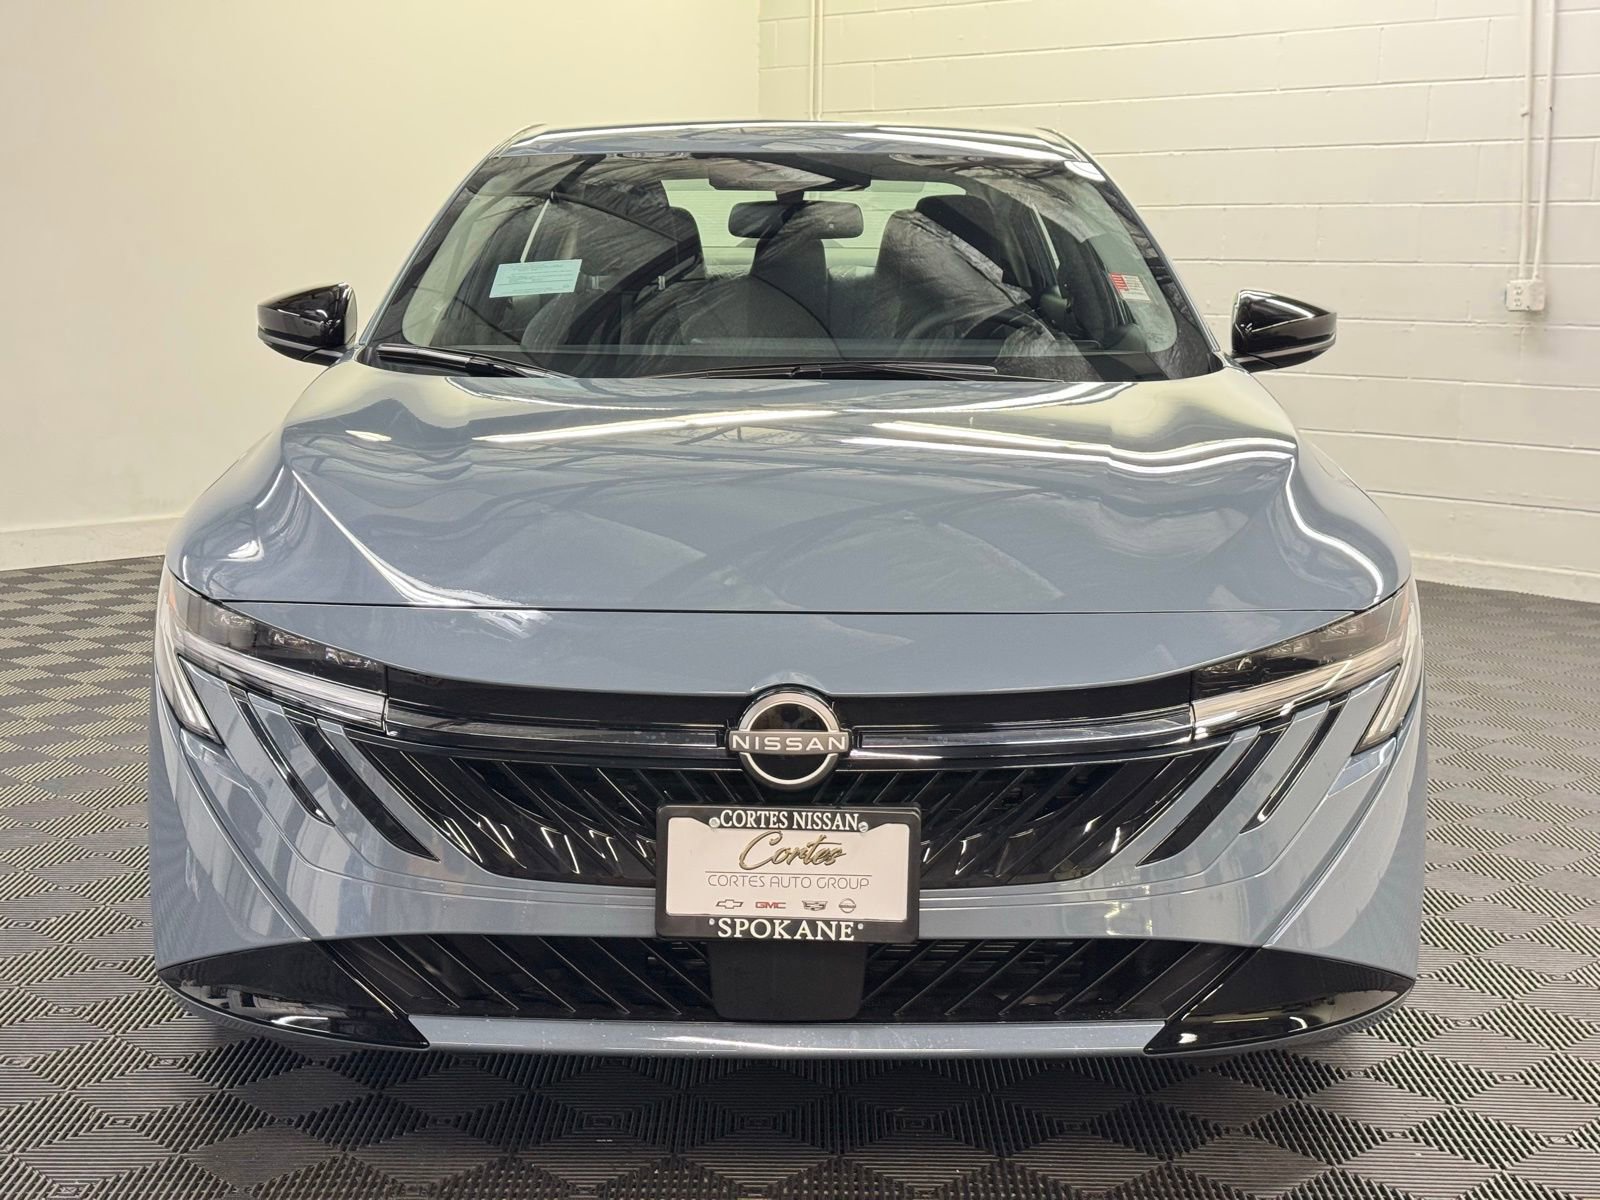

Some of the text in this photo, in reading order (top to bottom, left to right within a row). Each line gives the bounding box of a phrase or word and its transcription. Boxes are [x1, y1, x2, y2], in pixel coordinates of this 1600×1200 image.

[732, 735, 846, 751] NISSAN
[719, 809, 859, 831] CORTES NISSAN
[738, 830, 847, 870] Cortes
[707, 874, 870, 890] CORTES AUTO GROUP
[755, 901, 787, 910] GMC
[717, 918, 855, 941] SPOKANE
